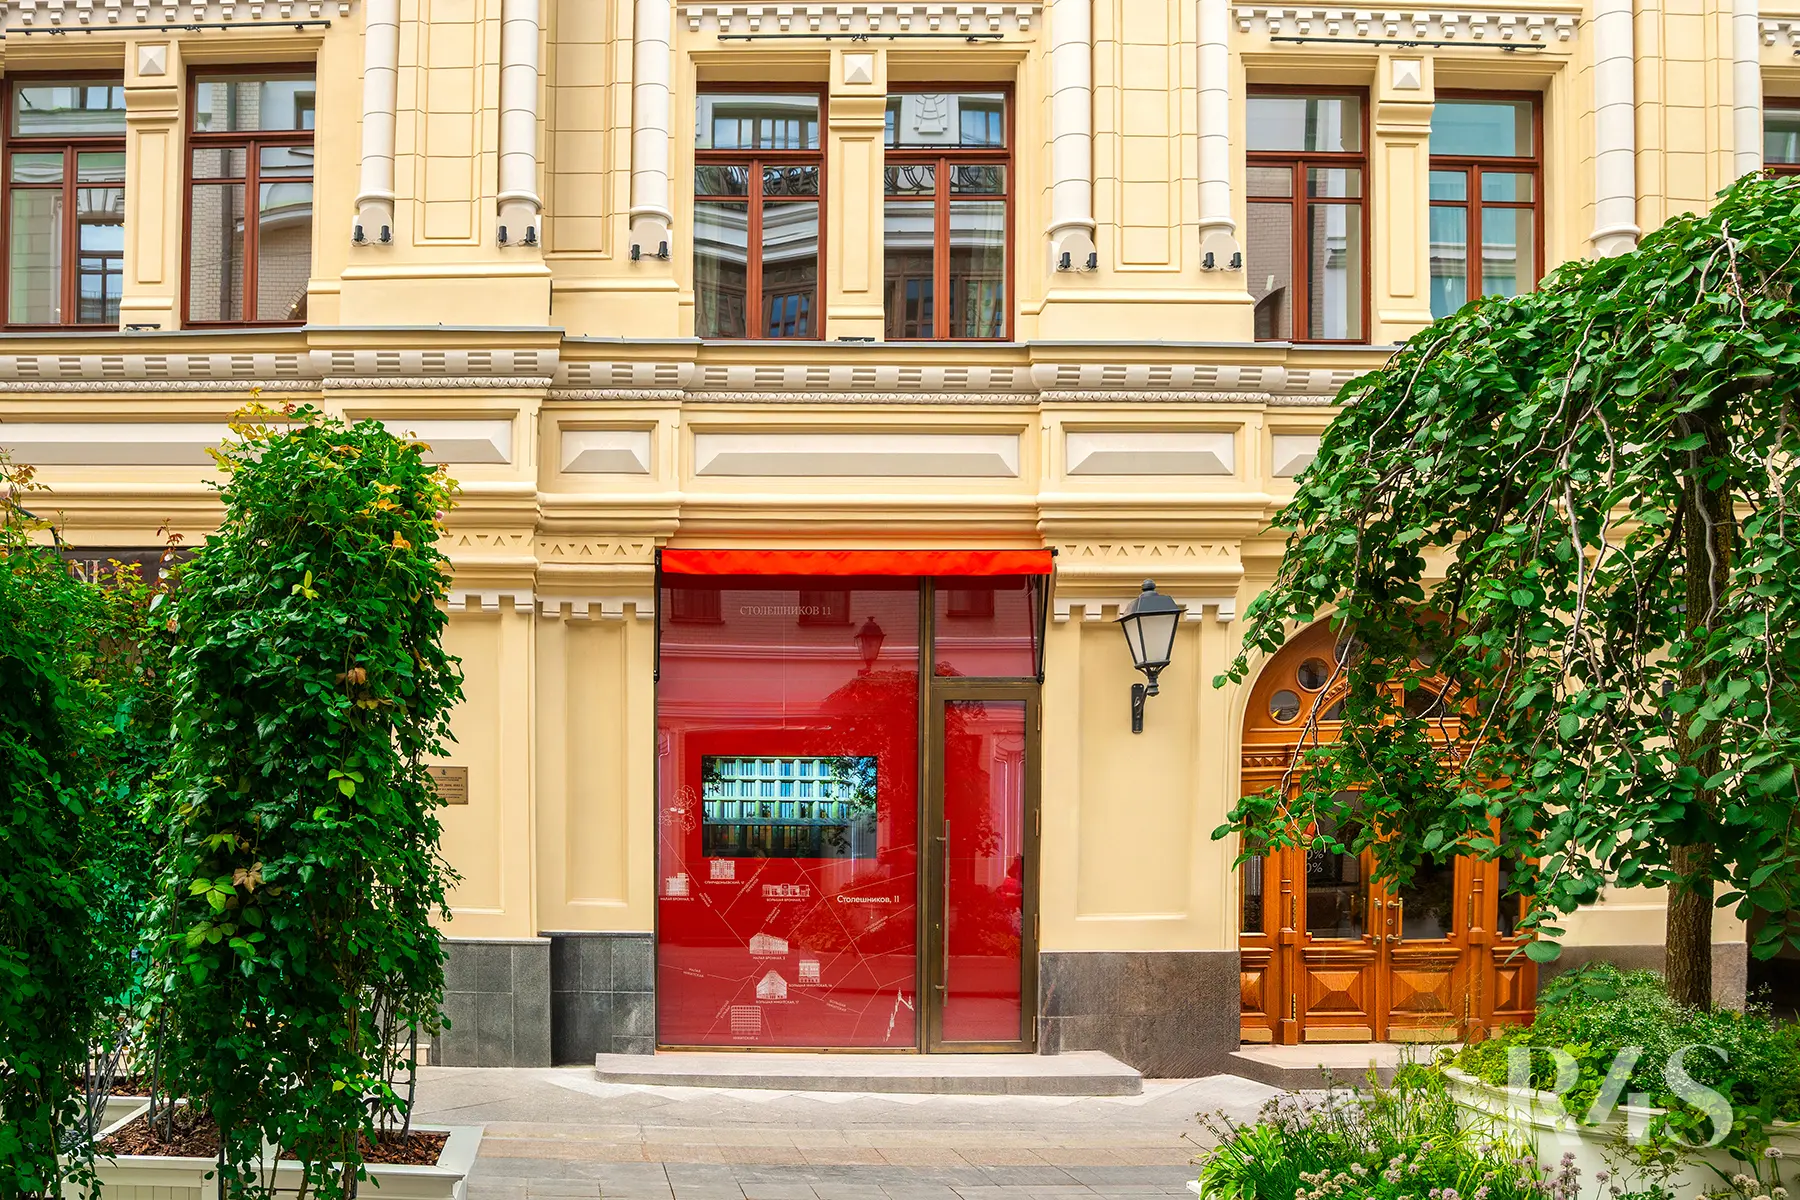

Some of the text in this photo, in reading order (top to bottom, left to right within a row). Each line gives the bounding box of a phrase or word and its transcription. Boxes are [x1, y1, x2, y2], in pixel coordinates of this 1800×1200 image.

[739, 605, 832, 616] СТОЛЕШНИКОВ 11
[837, 895, 900, 904] Столешников, 11
